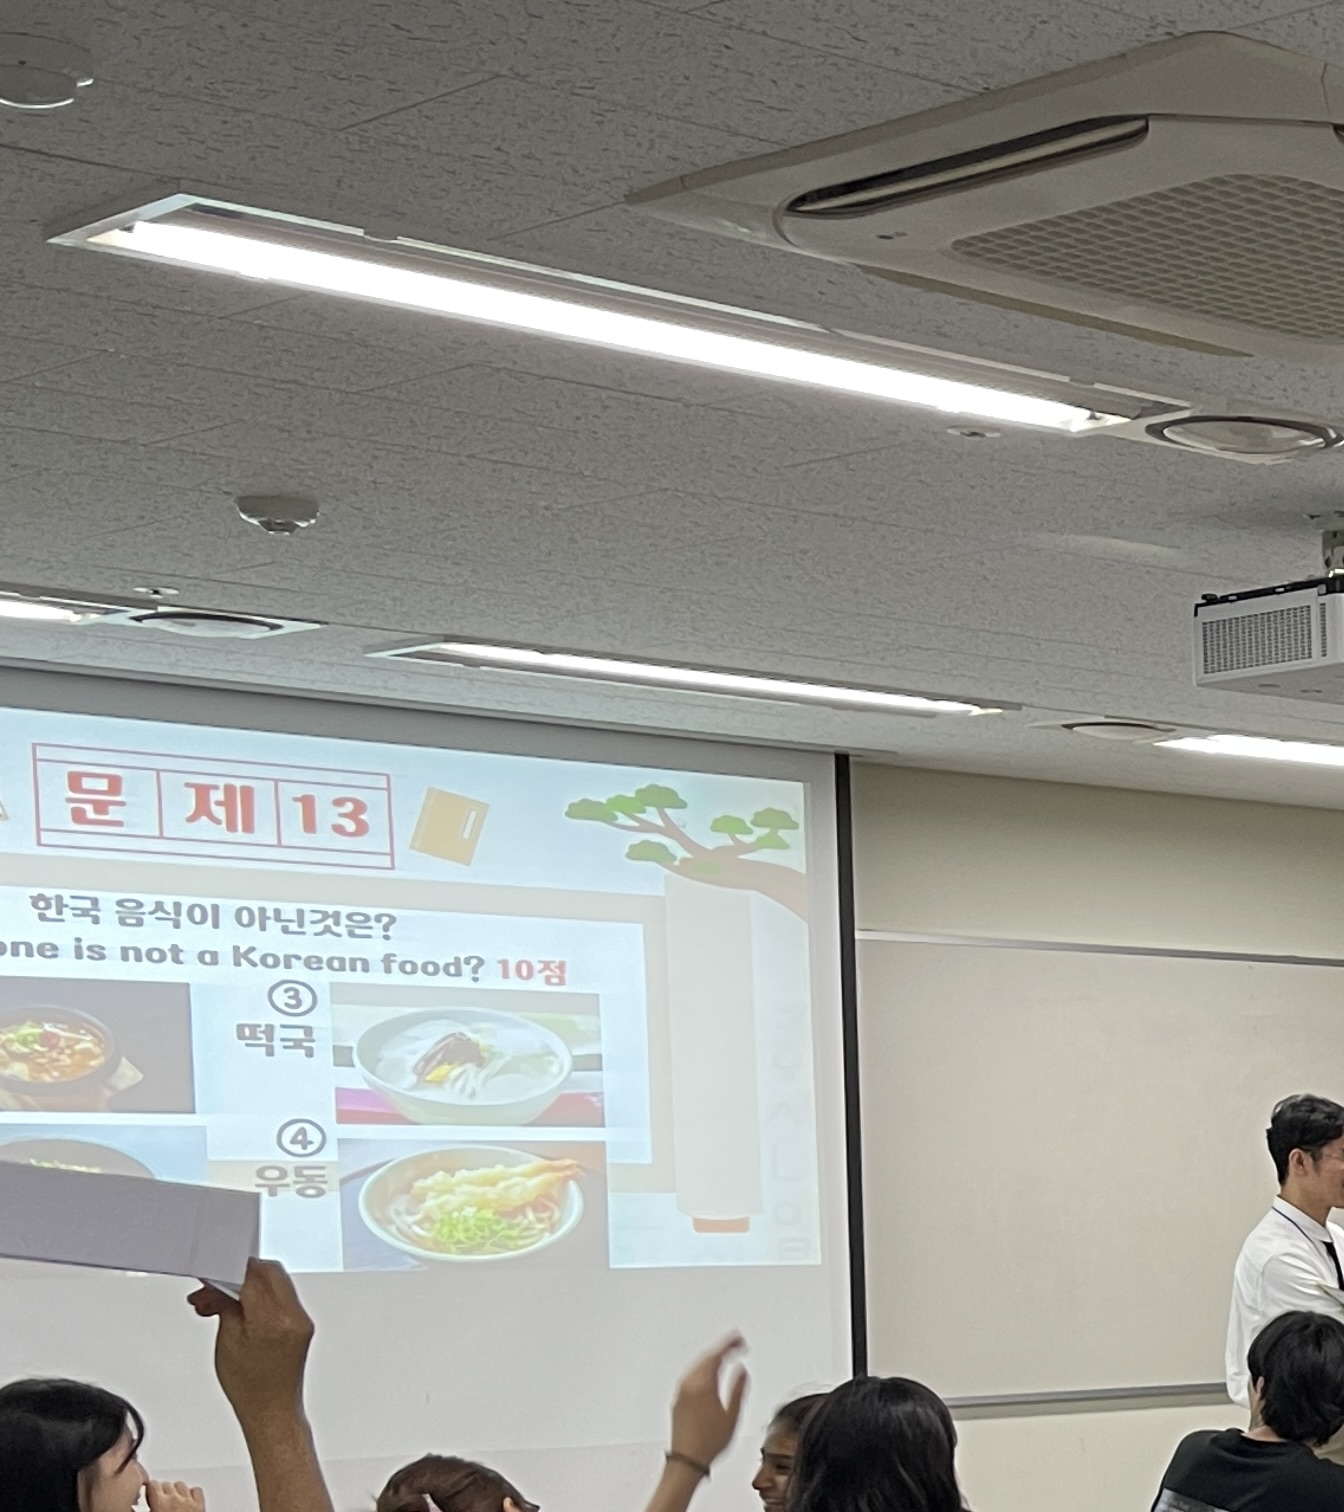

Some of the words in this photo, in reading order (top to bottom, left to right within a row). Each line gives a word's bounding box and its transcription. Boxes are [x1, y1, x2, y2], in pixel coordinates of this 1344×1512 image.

[292, 793, 370, 838] 13
[29, 892, 101, 925] 한국
[115, 898, 221, 930] 음식이
[234, 905, 397, 940] 아닌것은?
[74, 937, 107, 961] is
[120, 943, 185, 965] not
[197, 949, 220, 966] a
[232, 945, 370, 973] Korean
[380, 952, 485, 982] food?
[497, 958, 567, 987] 10점
[236, 1022, 316, 1058] 떡국
[254, 1165, 328, 1199] 우동
